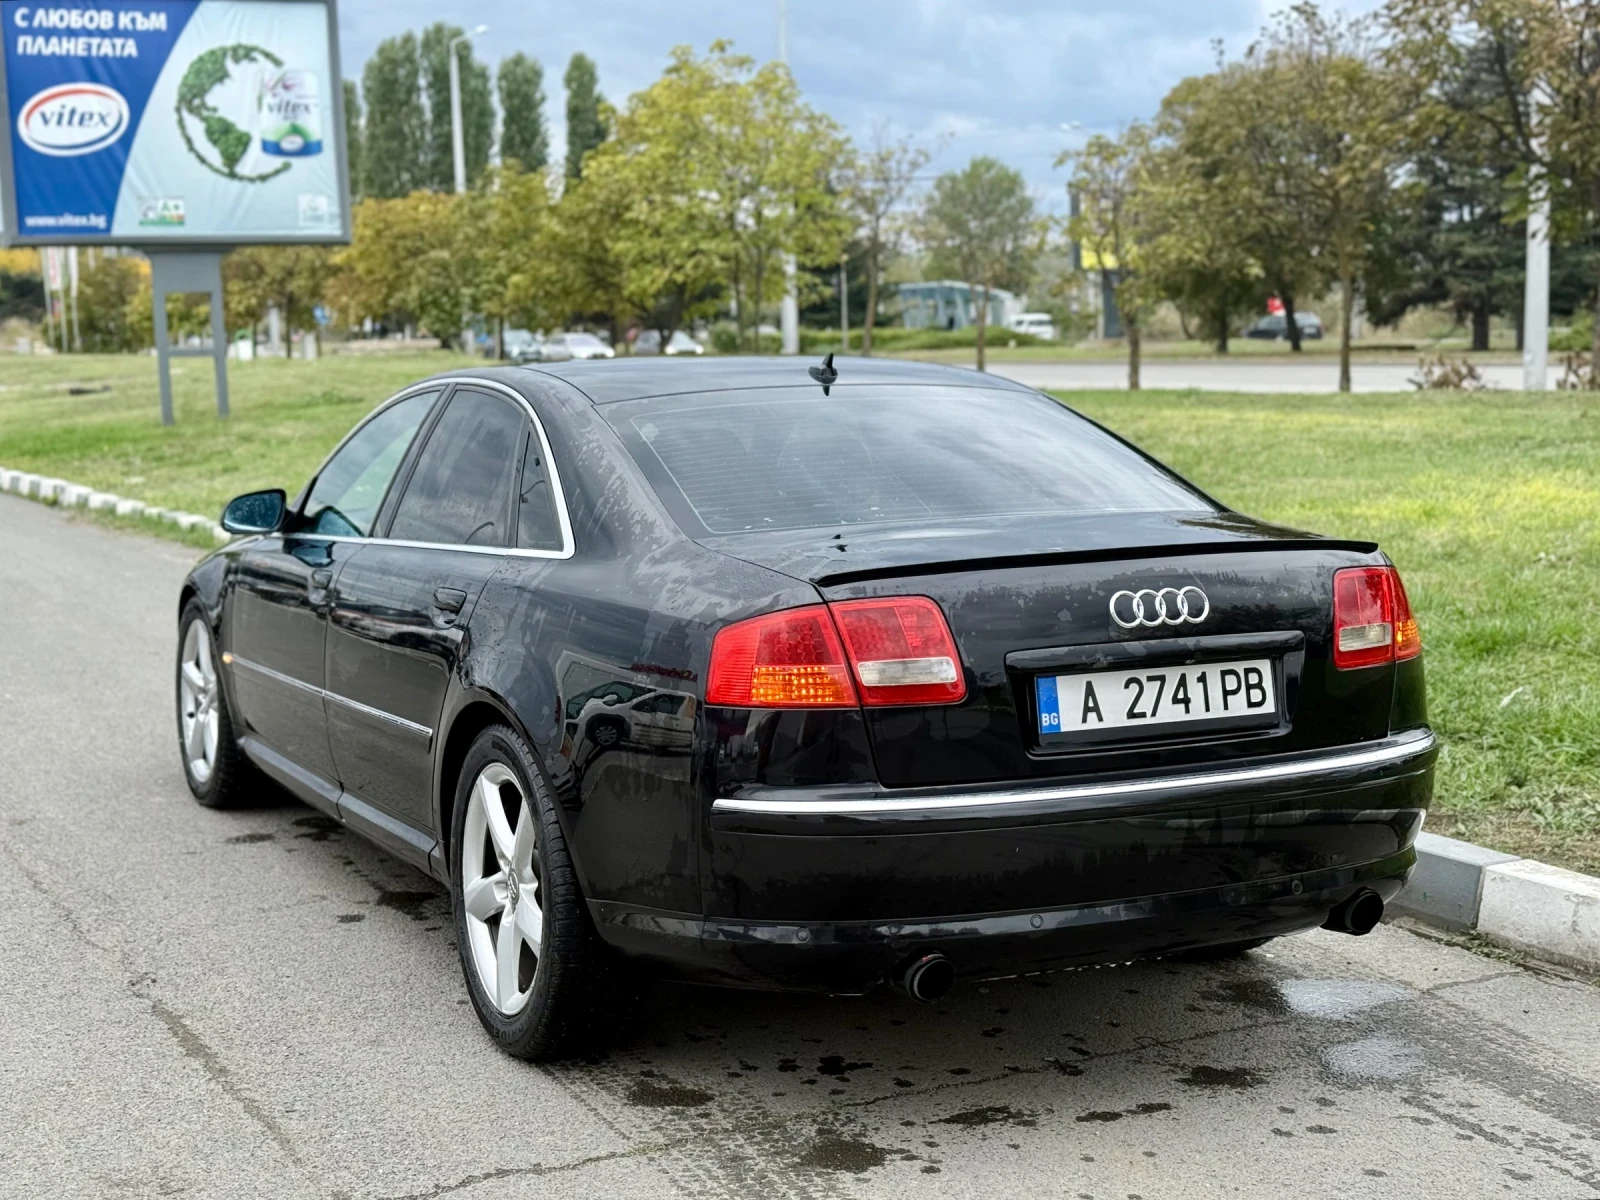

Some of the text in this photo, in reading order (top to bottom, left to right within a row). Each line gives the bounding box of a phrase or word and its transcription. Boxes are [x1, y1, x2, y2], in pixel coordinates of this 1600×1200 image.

[14, 6, 167, 31] С ЛЮБОВ КЪМ
[17, 34, 138, 58] ПЛАНЕТАТА
[39, 104, 111, 127] vitex
[1081, 680, 1104, 724] A
[1041, 712, 1059, 727] BG
